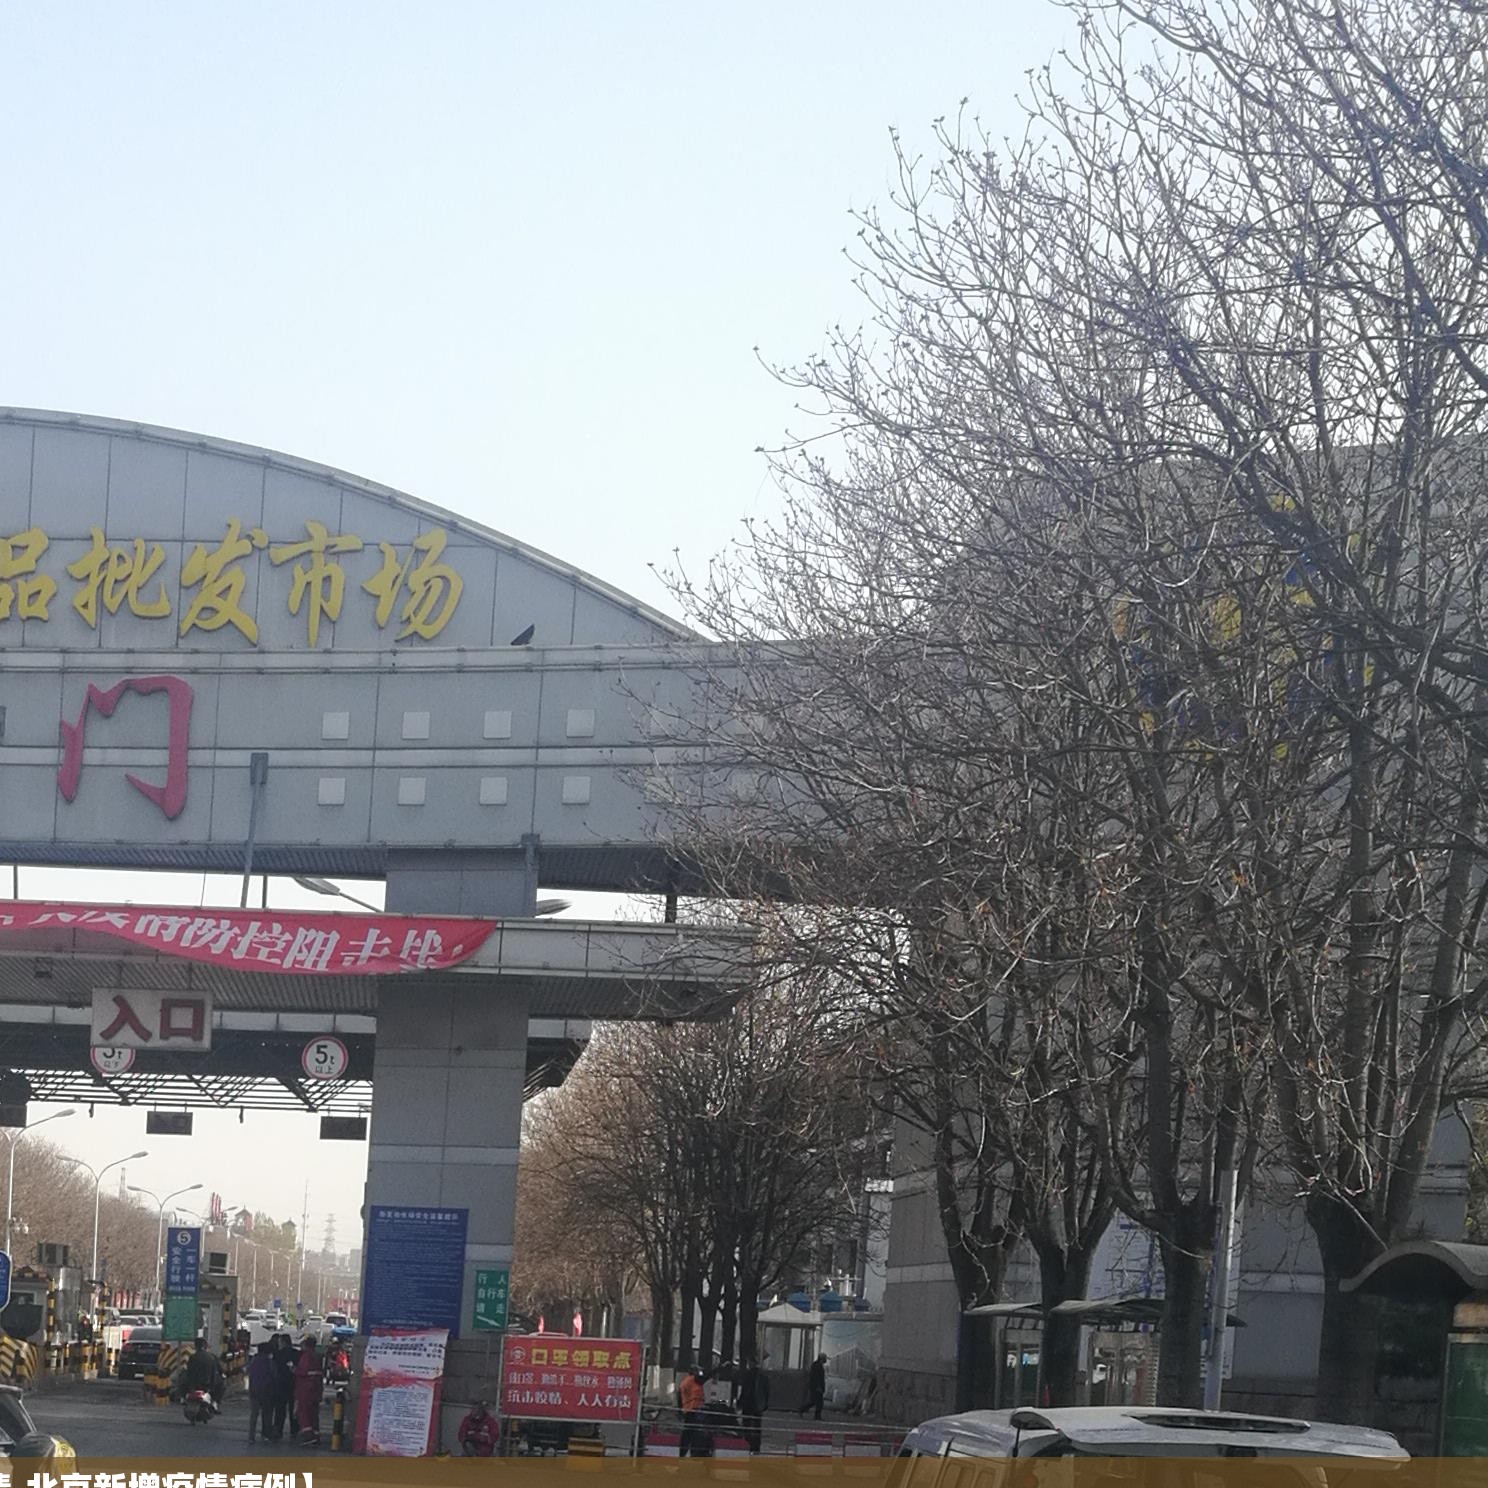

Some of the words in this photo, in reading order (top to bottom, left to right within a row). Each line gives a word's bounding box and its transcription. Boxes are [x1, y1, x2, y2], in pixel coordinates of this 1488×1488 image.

[100, 995, 204, 1042] 入口
[530, 1348, 632, 1370] 口罩领取点
